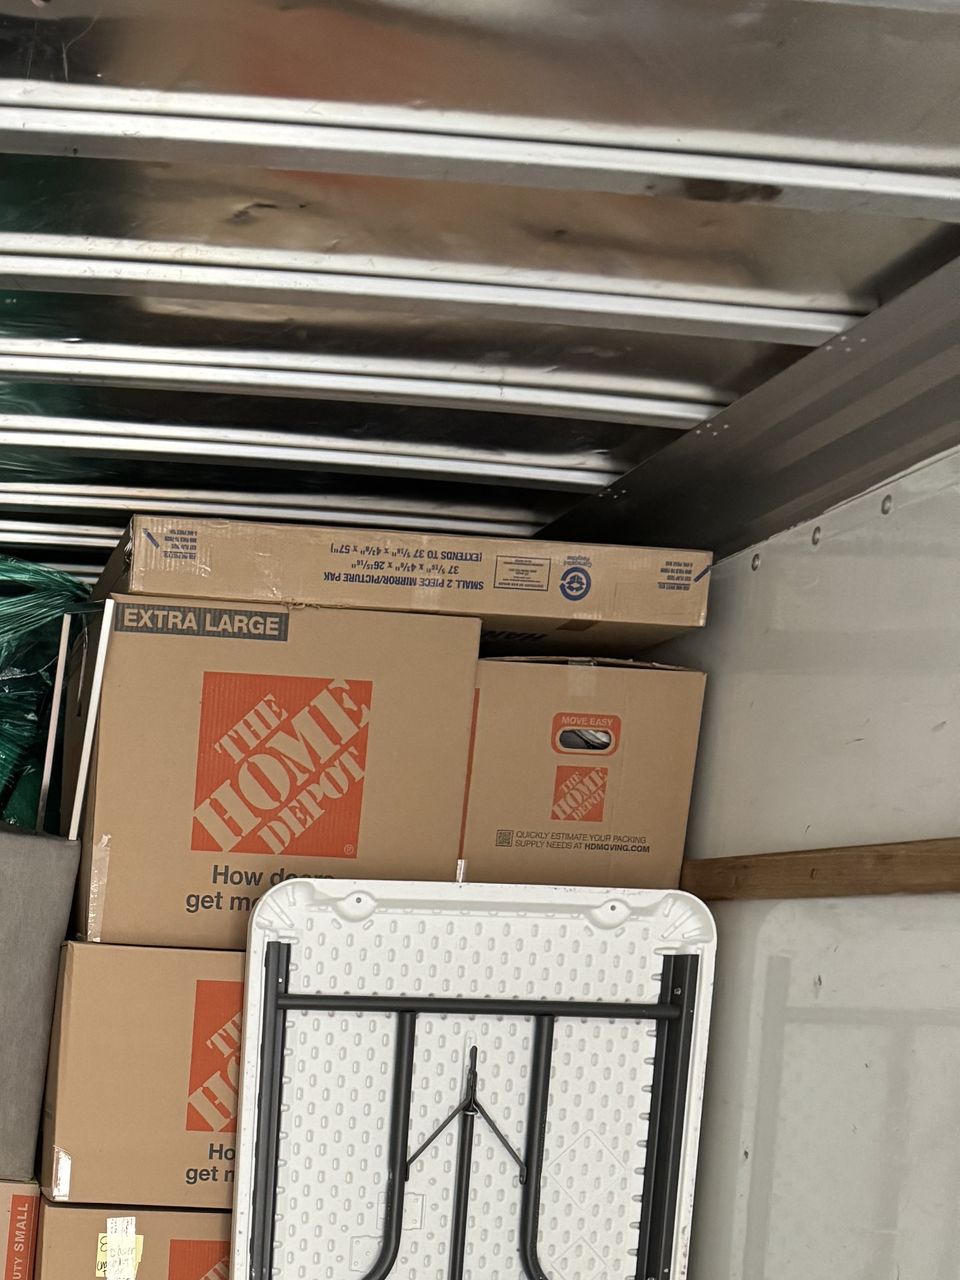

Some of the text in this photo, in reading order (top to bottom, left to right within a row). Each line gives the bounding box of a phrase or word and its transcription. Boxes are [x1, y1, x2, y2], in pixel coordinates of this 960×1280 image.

[414, 549, 424, 558] 37
[427, 550, 438, 560] TO
[448, 565, 459, 574] 37
[324, 572, 484, 590] SMALL 2 PIECE MIRROR/PICTURE PAK
[123, 608, 280, 636] EXTRA LARGE
[214, 693, 288, 764] THE
[562, 716, 614, 727] MOVE EASY
[194, 679, 371, 854] HOME
[560, 772, 583, 793] THE
[257, 746, 366, 855] DEPOT
[552, 768, 608, 820] HOME
[572, 789, 605, 820] DEPOT
[515, 839, 545, 848] SUPPLY
[546, 841, 572, 849] NEEDS
[585, 843, 650, 853] HDMOVING.COM
[516, 831, 647, 844] QUICKLY ESTIMATE YOUR PACKING
[212, 865, 263, 886] How
[186, 892, 223, 913] get
[208, 1143, 236, 1160] Ho
[185, 1166, 218, 1185] get
[14, 1203, 28, 1252] SMALL
